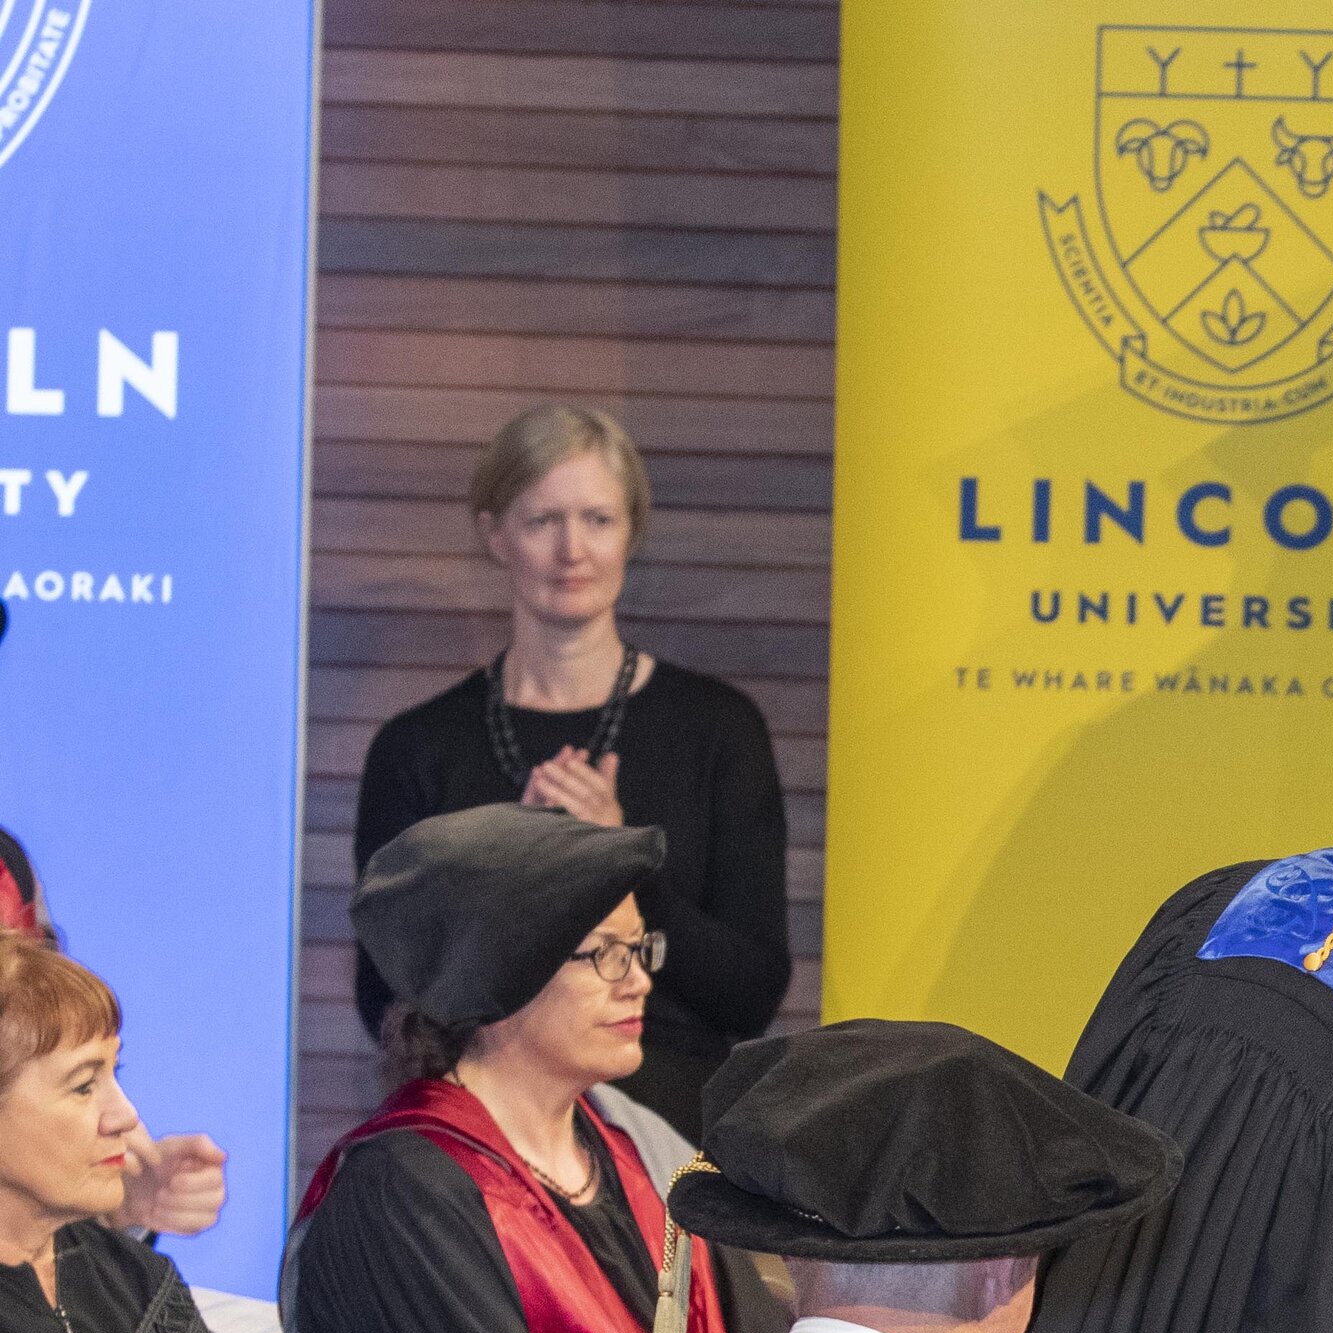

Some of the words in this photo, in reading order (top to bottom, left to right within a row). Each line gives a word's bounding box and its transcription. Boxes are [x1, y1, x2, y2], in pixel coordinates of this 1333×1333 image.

[0, 8, 71, 136] ROBITATE
[3, 570, 173, 604] AORAKI
[954, 667, 992, 691] TE
[1012, 668, 1135, 693] WHARE
